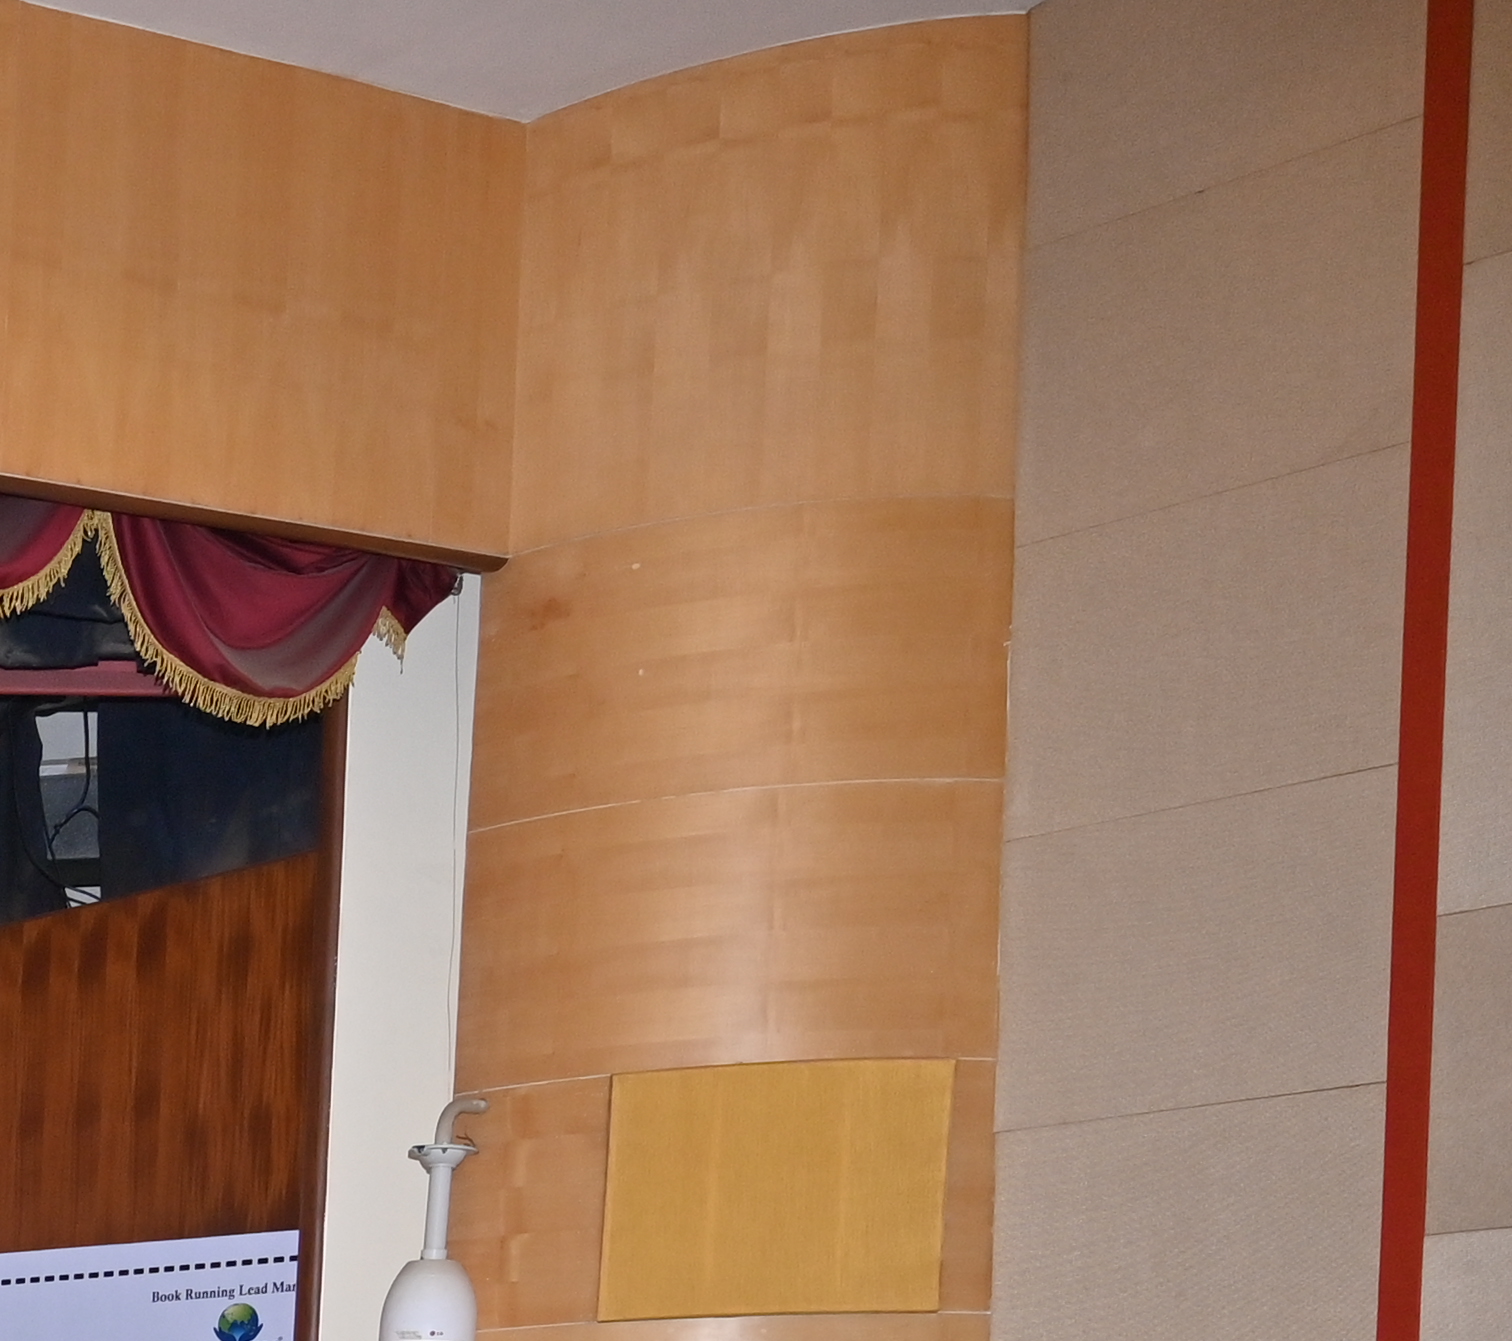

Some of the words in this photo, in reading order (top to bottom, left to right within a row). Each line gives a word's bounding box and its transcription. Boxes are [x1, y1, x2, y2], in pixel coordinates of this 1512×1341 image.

[152, 1290, 181, 1302] Book
[186, 1287, 235, 1300] Running
[240, 1283, 267, 1295] Lead
